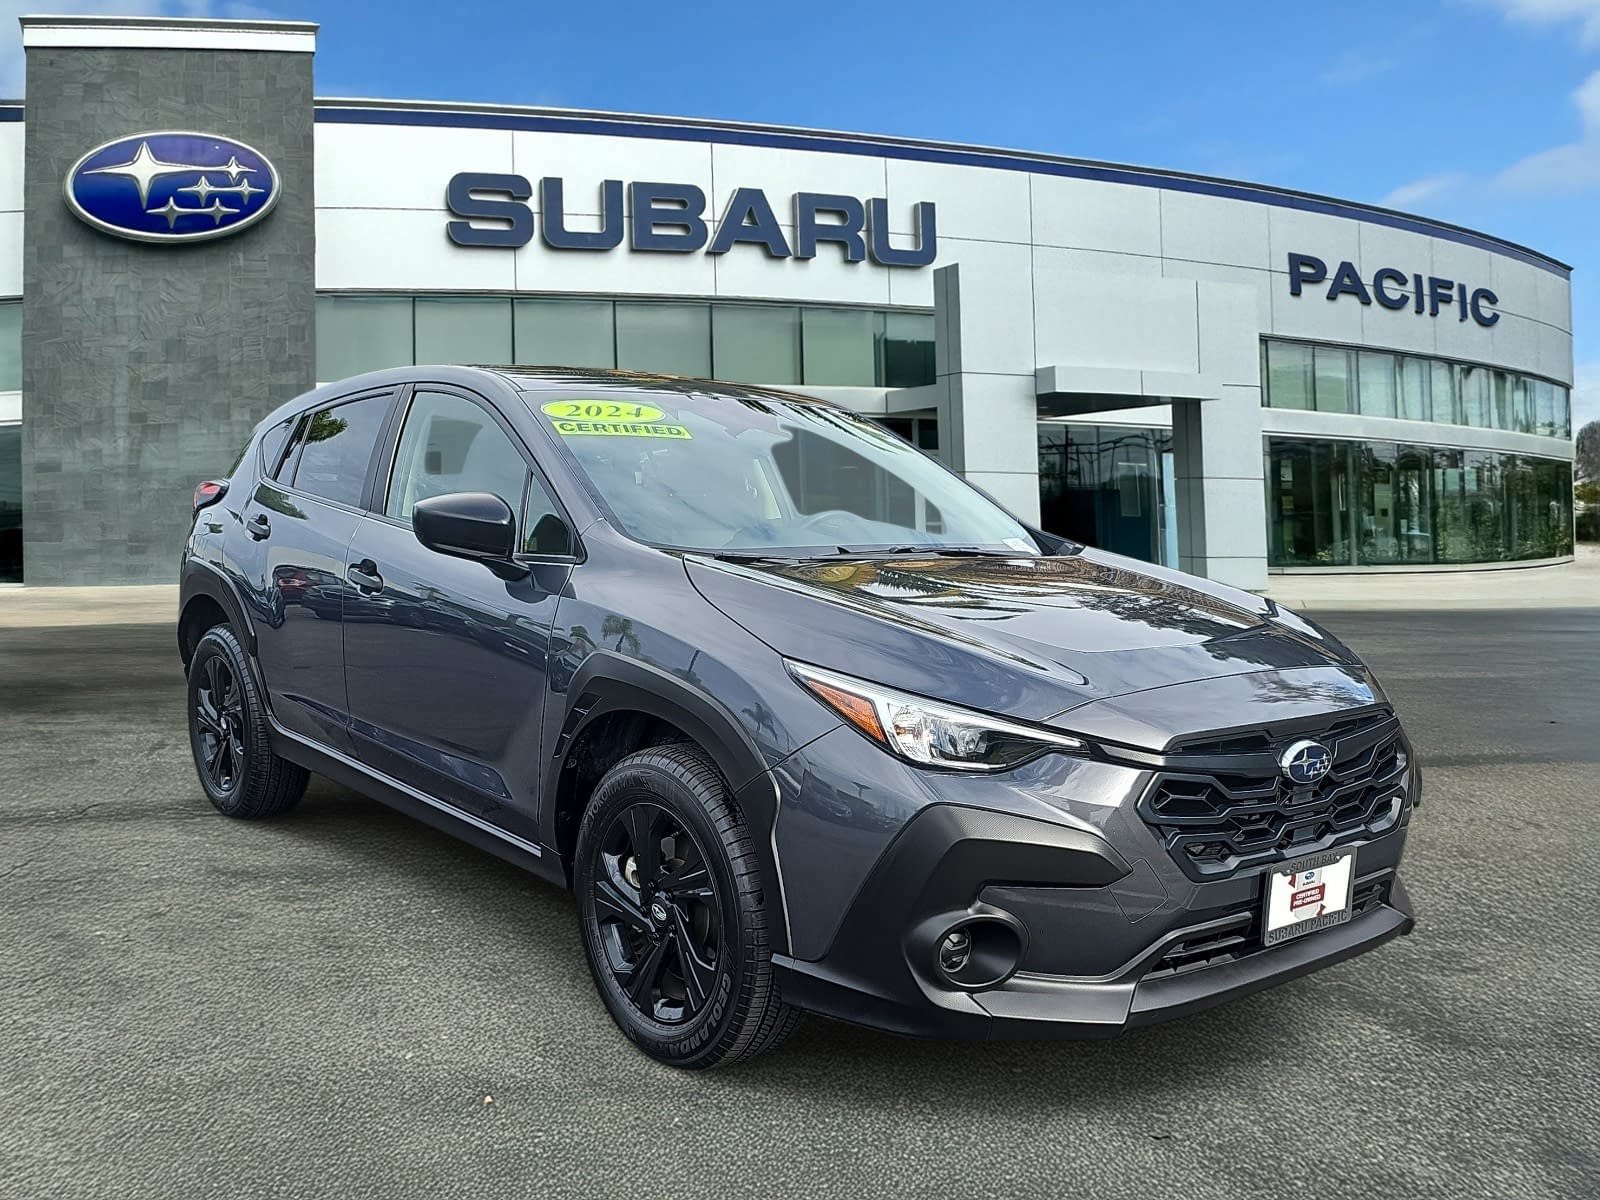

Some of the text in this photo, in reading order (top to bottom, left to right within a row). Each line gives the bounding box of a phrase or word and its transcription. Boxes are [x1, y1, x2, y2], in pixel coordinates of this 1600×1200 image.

[446, 171, 938, 268] SUBARU
[1287, 251, 1501, 327] PACIFIC
[566, 404, 643, 418] 2024
[558, 422, 683, 436] CERTIFIED
[1290, 856, 1320, 871] SOUTH
[1269, 912, 1347, 943] SUBARU PACIFIC
